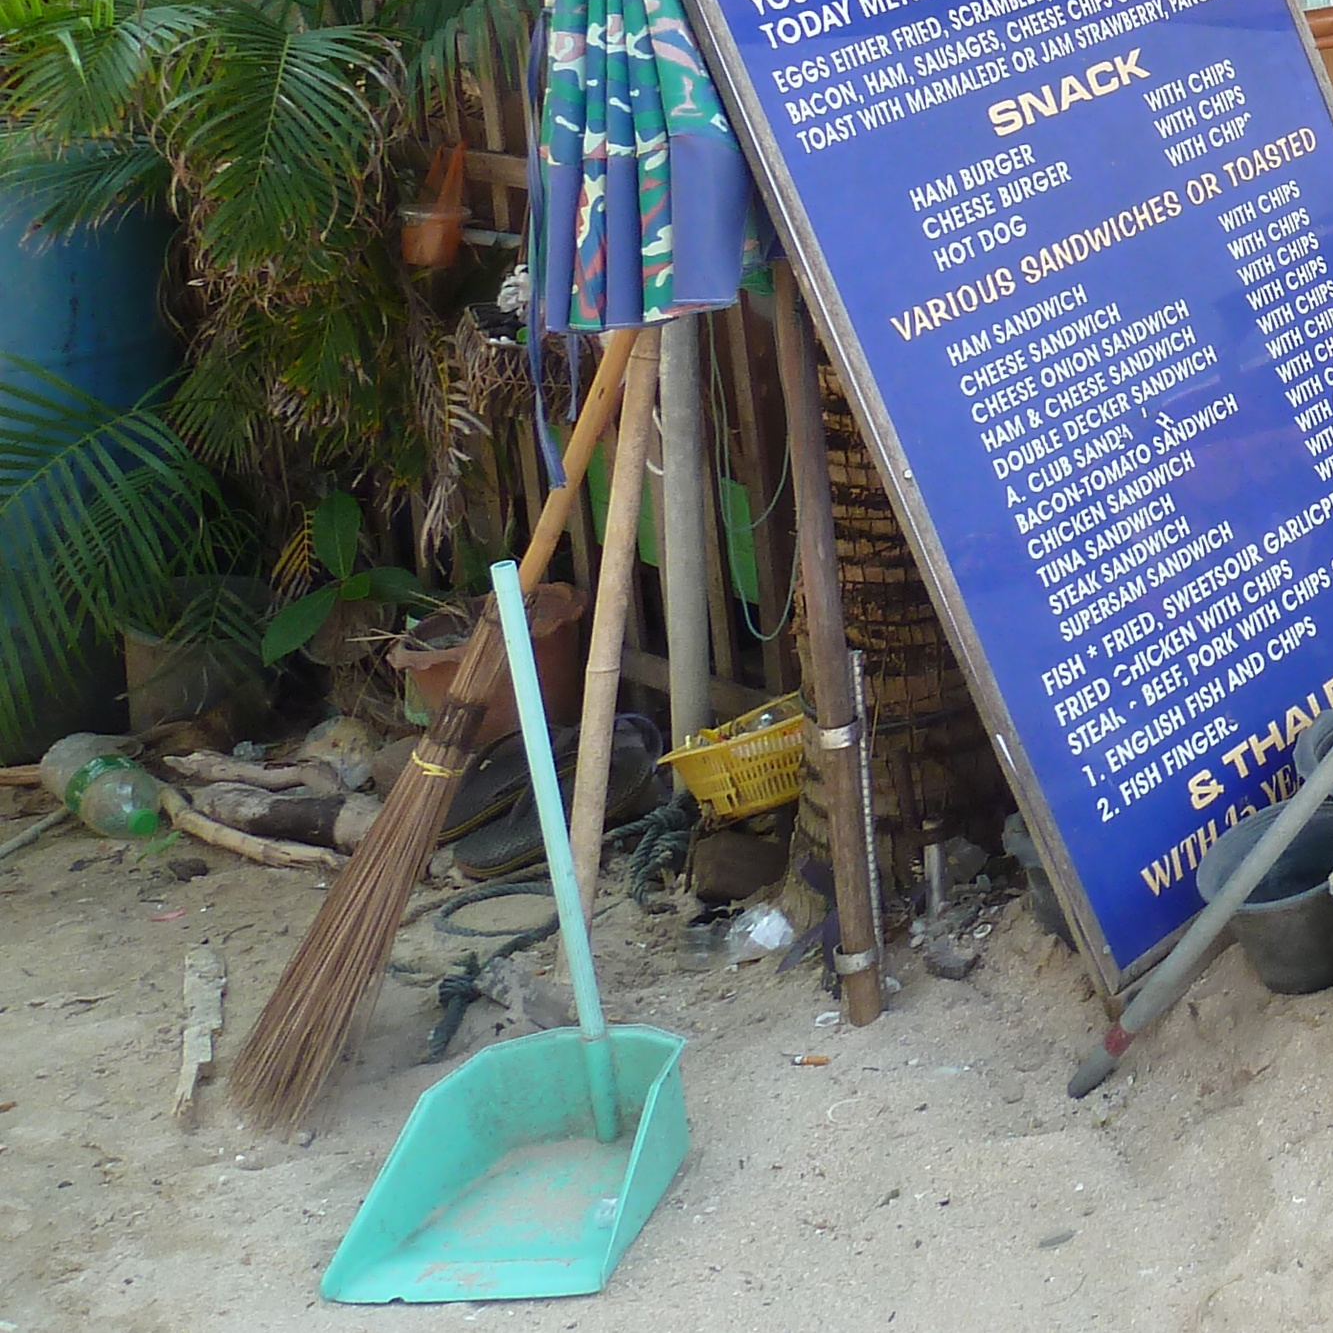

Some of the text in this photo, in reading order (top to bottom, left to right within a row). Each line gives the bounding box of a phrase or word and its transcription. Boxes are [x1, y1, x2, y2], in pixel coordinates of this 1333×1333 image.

[772, 56, 830, 93] EGGS
[830, 35, 892, 72] EITHER
[891, 17, 949, 51] FRIED,
[785, 81, 864, 124] BACON,
[863, 63, 914, 95] HAM,
[914, 29, 1006, 76] SAUSAGES,
[1007, 5, 1066, 42] CHEESE
[796, 114, 856, 153] TOAST
[856, 97, 905, 130] WITH
[905, 57, 1010, 113] MARMALEDE
[1012, 47, 1039, 72] OR
[1041, 33, 1075, 62] JAM
[988, 48, 1150, 136] SNACK
[1143, 60, 1235, 111] WITH CHIPS
[1154, 86, 1245, 138] WITH CHIPS
[1164, 134, 1207, 166] WITH
[909, 145, 1035, 211] HAM BURGER
[922, 162, 1072, 239] CHEESE BURGER
[1218, 180, 1300, 232] WITH CHIPS
[890, 128, 1316, 340] VARIOUS SANDWICHES OR TOASTED
[933, 216, 1026, 271] HOT DOG
[1227, 208, 1309, 260] WITH CHIPS
[1237, 232, 1318, 285] WITH CHIPS
[1246, 256, 1327, 310] WITH CHIPS
[1256, 303, 1295, 335] WITH
[947, 284, 1087, 366] HAM SANDWICH
[960, 303, 1121, 396] CHEESE SANDWICH
[972, 299, 1189, 423] CHEESE ONION SANDWICH
[1265, 327, 1304, 359] WITH
[981, 326, 1196, 452] HAM & CHEESE SANDWICH
[1275, 350, 1314, 383] WITH
[1285, 374, 1323, 408] WITH
[993, 345, 1217, 479] DOUBLE DECKER SANDWICH
[1294, 399, 1333, 432] WITH
[1015, 393, 1238, 534] BACON-TOMATO SANDWICH
[1028, 456, 1073, 492] CLUB
[1028, 449, 1195, 559] CHICKEN SANDWICH
[1036, 493, 1175, 587] TUNA SANDWICH
[1049, 516, 1190, 615] STEAK SANDWICH
[1060, 521, 1233, 642] SUPERSAM SANDWICH
[1042, 654, 1086, 696] FISH
[1102, 612, 1163, 658] FRIED,
[1163, 544, 1263, 619] SWEETSOUR
[1054, 559, 1292, 726] FRIED CHICKEN WITH CHIPS
[1141, 664, 1188, 706] BEEF,
[1187, 628, 1238, 676] PORK
[1236, 600, 1281, 640] WITH
[1282, 567, 1330, 611] CHIPS
[1082, 616, 1316, 787] 1. ENGLISH FISH AND CHIPS
[1188, 769, 1225, 810] &
[1222, 693, 1320, 778] THAI
[1097, 798, 1119, 822] 2.
[1119, 762, 1162, 806] FISH
[1140, 824, 1220, 897] WITH
